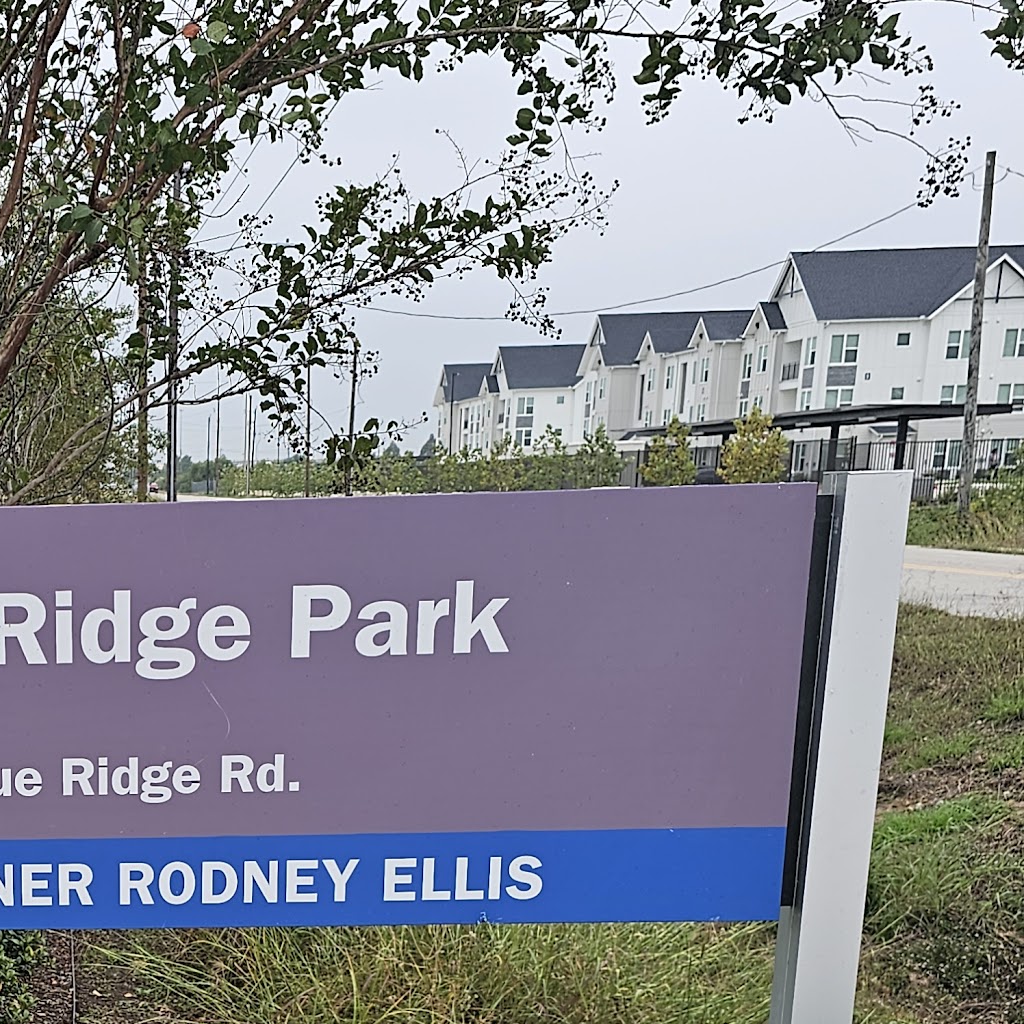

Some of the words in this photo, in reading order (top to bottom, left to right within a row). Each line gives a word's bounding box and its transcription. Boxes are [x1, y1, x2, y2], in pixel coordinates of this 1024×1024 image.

[290, 579, 510, 658] Park
[62, 756, 201, 804] Ridge
[220, 753, 301, 794] Rd.
[118, 858, 360, 905] RODNEY
[383, 854, 543, 903] ELLIS
